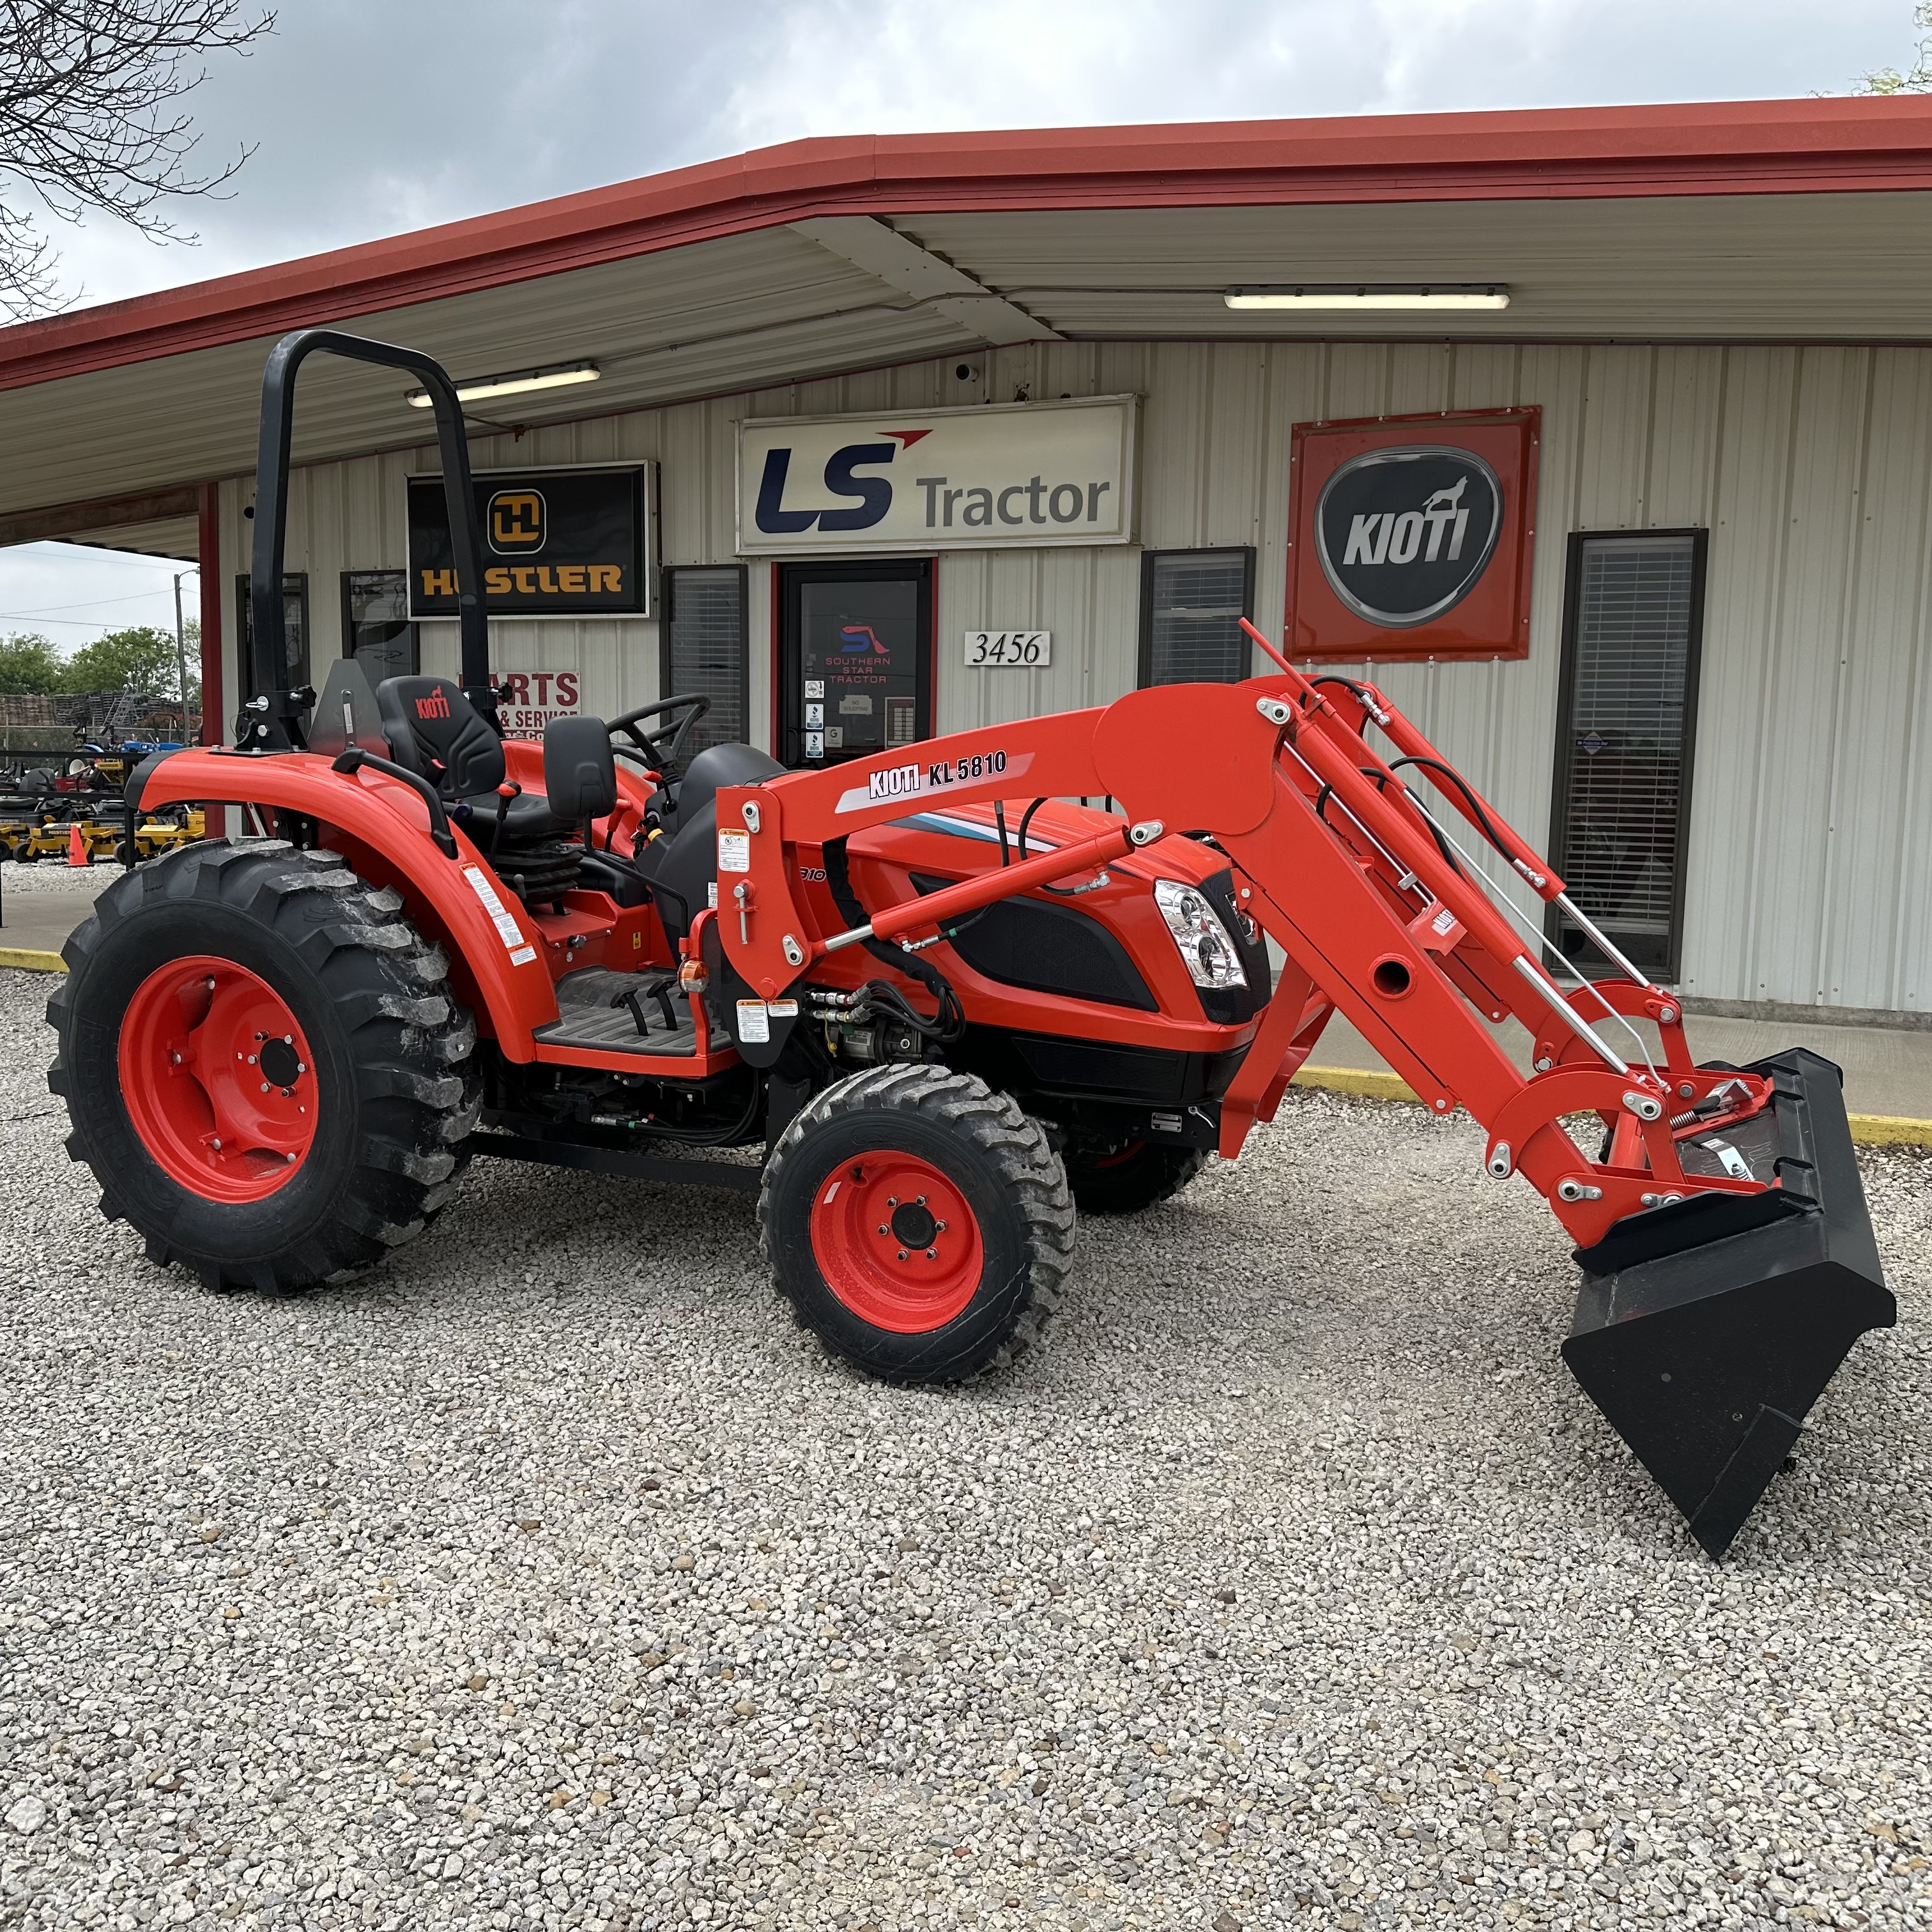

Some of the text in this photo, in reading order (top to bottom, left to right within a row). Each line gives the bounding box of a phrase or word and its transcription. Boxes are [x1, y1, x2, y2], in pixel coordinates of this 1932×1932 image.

[755, 443, 1110, 533] LS Tractor
[1342, 509, 1470, 565] KIOTI
[422, 565, 622, 595] HSTLER
[972, 634, 1043, 663] 3456
[459, 673, 578, 706] RTS
[415, 697, 450, 719] KIOTI
[500, 710, 578, 728] & SERV
[870, 749, 1008, 799] KIOTI KL 5810
